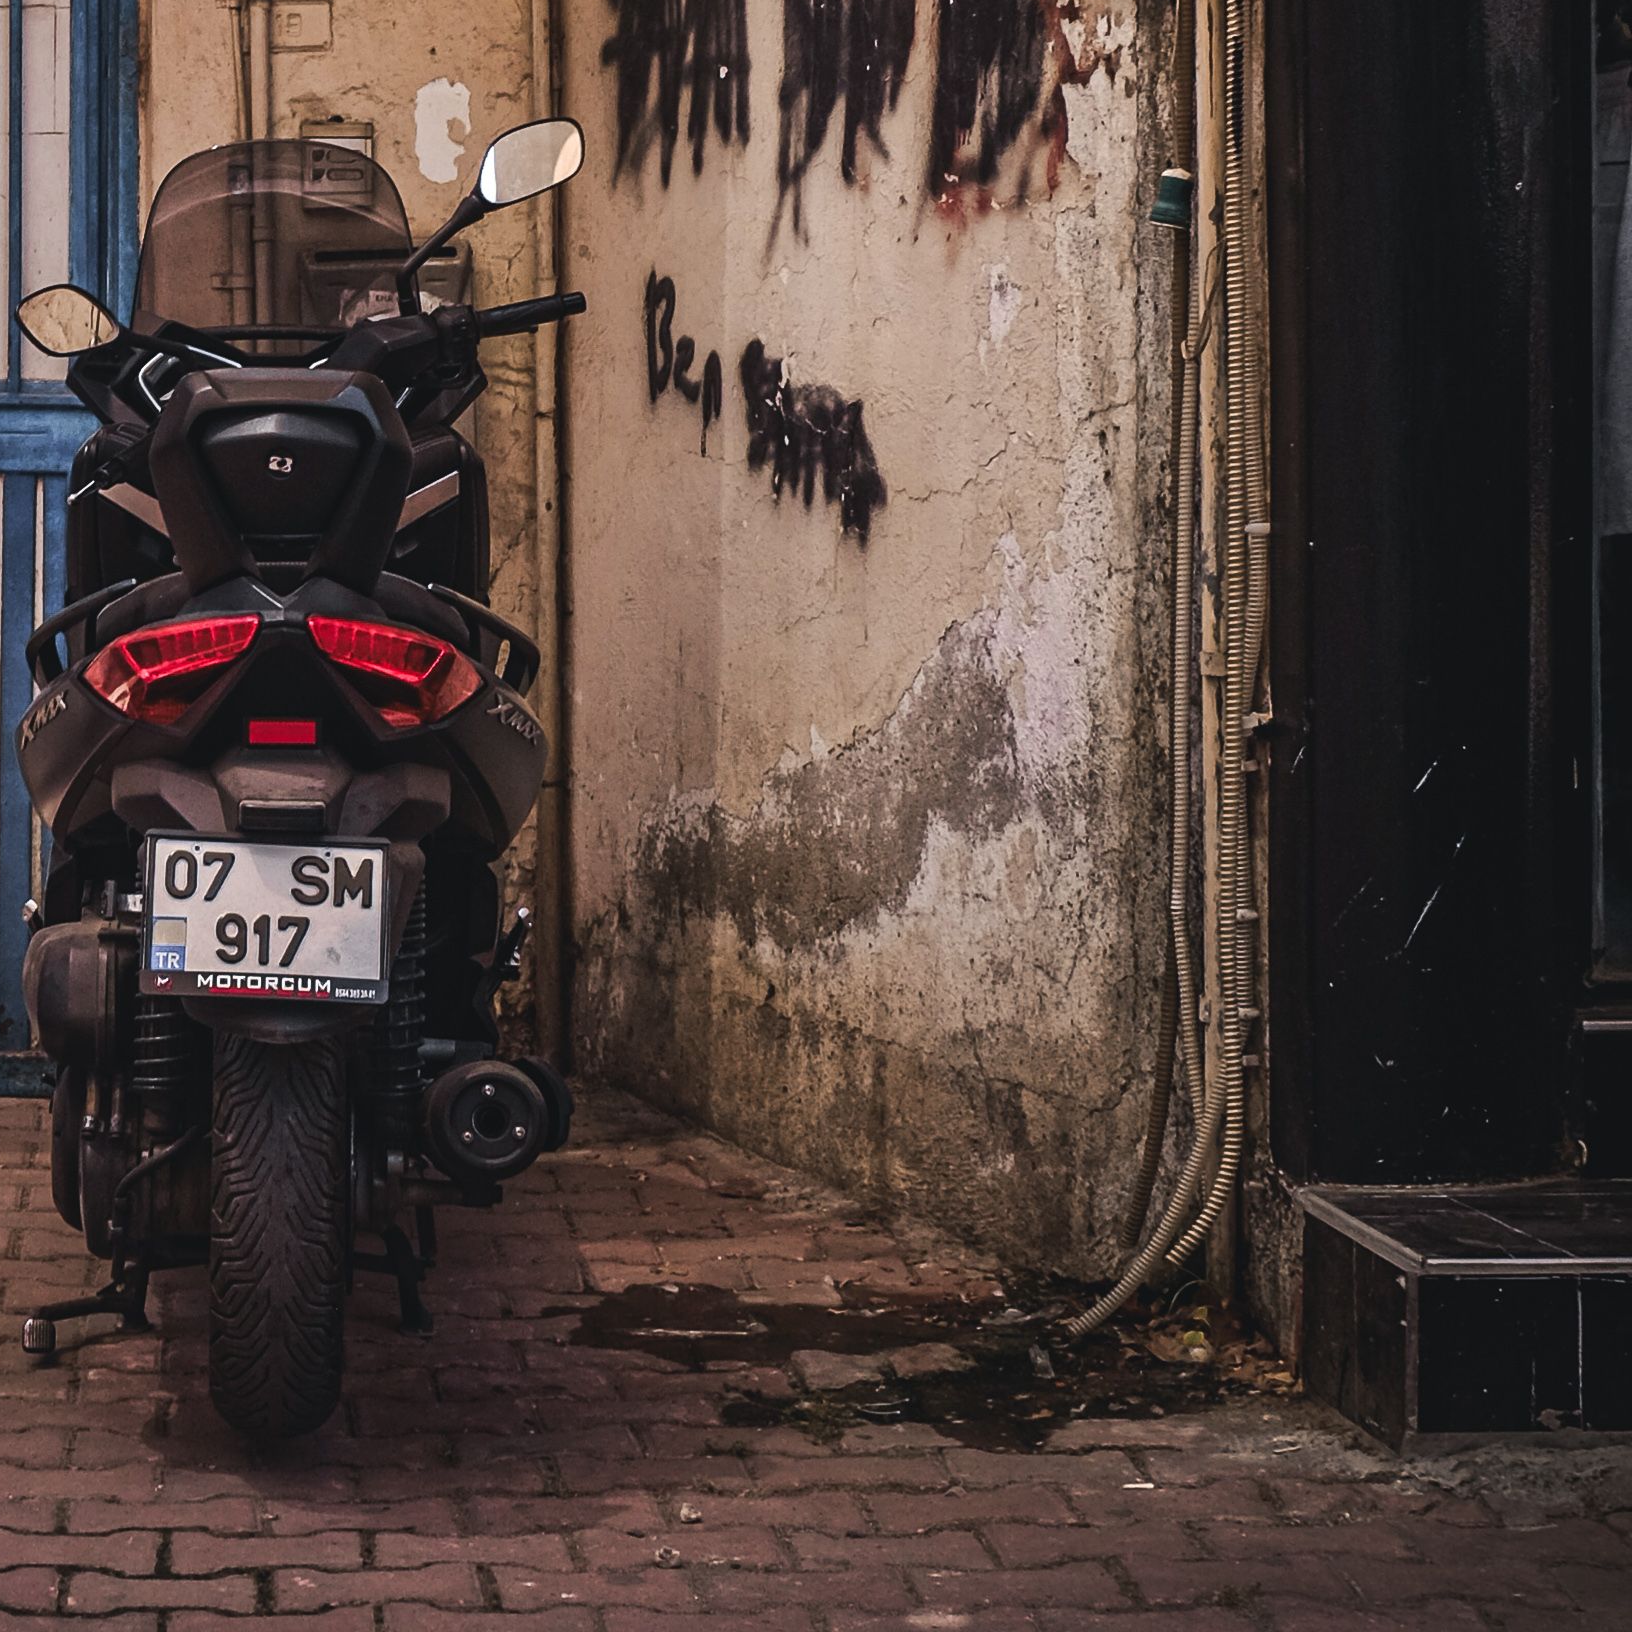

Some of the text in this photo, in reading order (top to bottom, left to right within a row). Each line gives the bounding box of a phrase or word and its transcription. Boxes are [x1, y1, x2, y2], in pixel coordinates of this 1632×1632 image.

[165, 850, 373, 908] 07 SM
[215, 913, 310, 967] 917
[156, 952, 180, 968] TR
[197, 973, 331, 993] MOTORCUM
